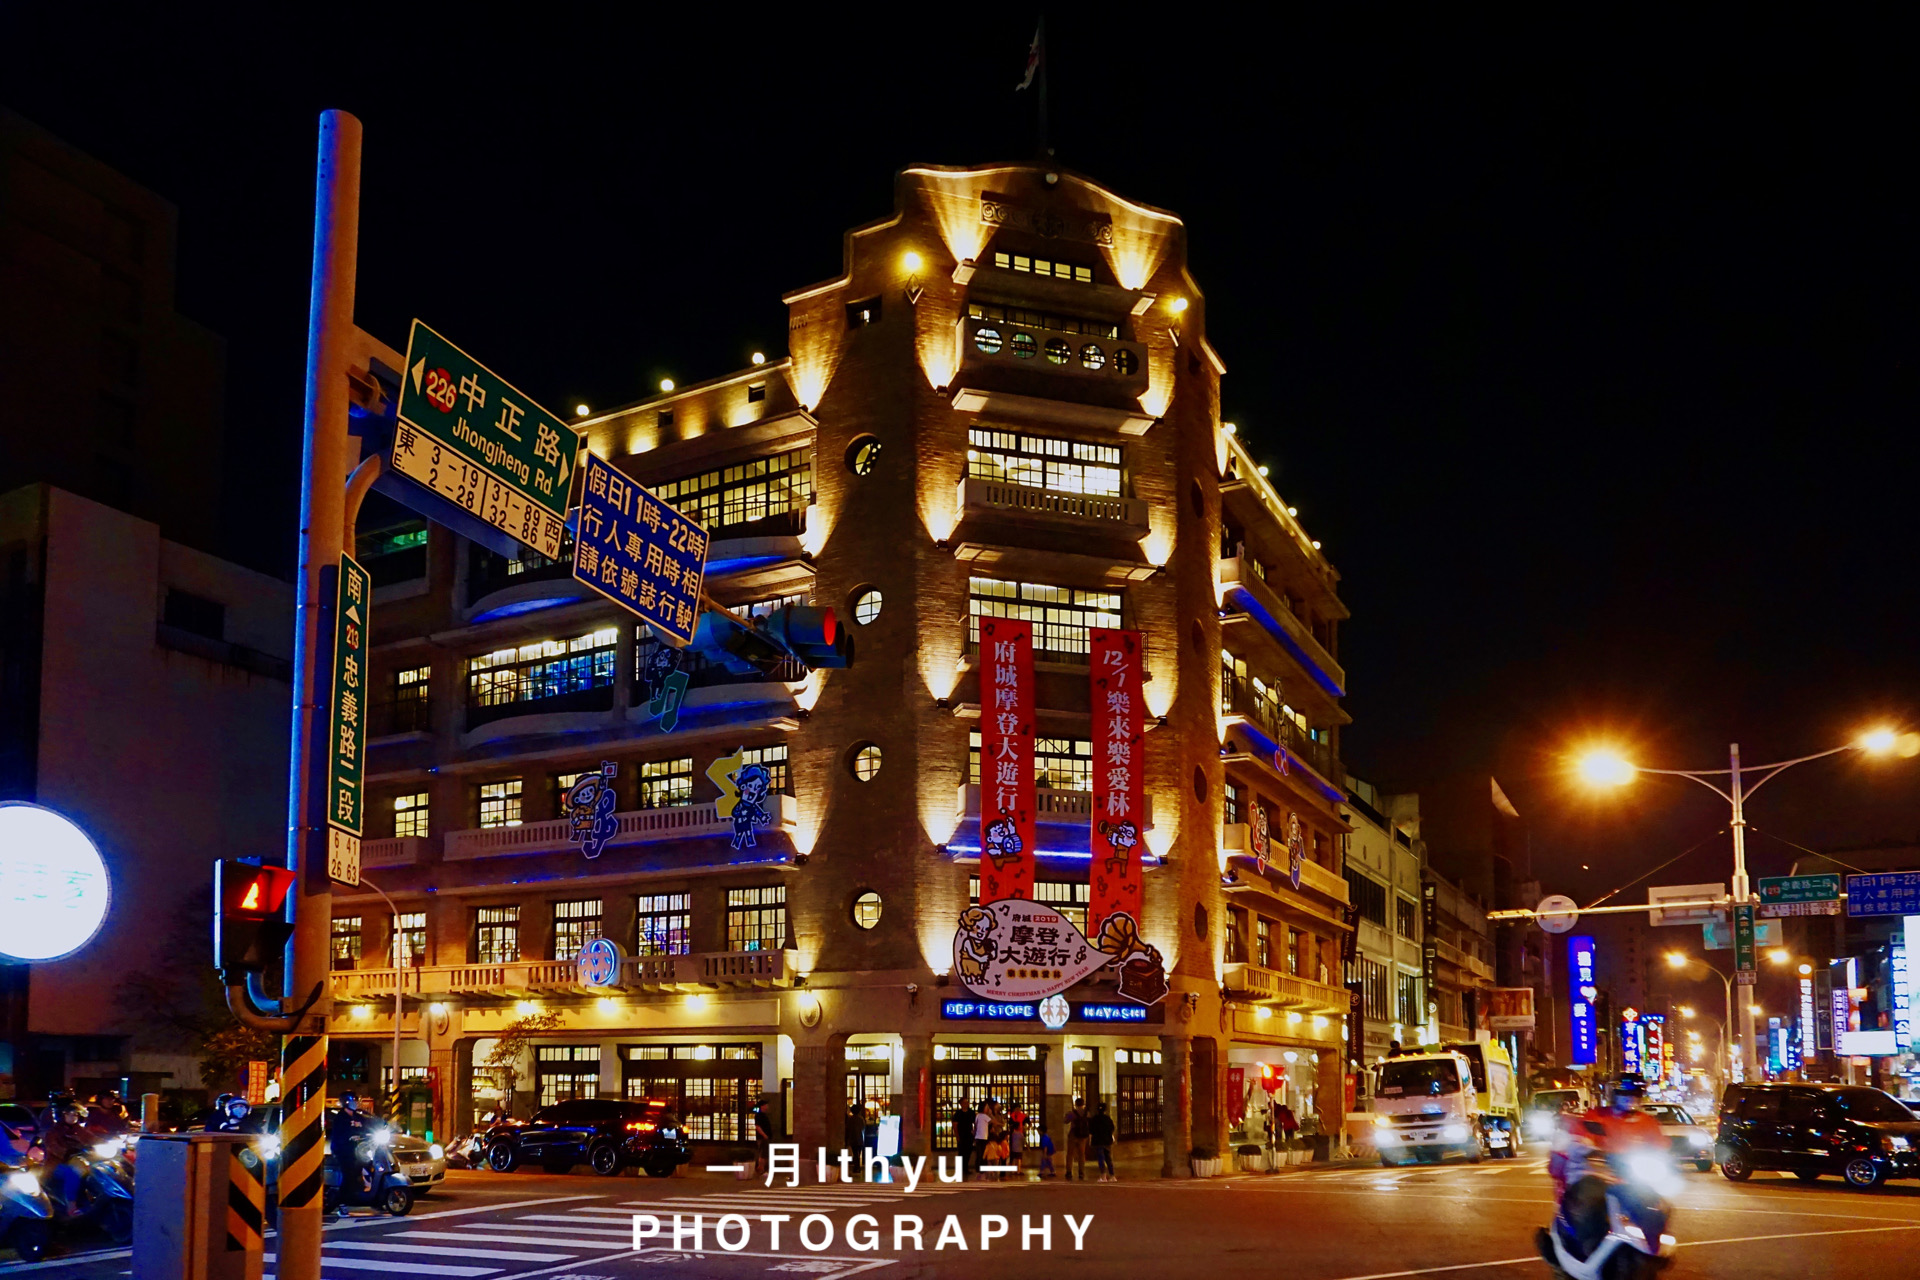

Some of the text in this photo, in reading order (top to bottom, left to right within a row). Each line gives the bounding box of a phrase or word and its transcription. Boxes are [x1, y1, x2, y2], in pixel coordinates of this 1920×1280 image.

[426, 371, 561, 468] 226 中正路
[396, 427, 419, 457] 東
[452, 416, 553, 497] Jhongjheng Rd.
[392, 452, 406, 471] E.
[544, 515, 563, 544] 西
[583, 503, 700, 600] 行人專用時相
[347, 566, 363, 605] 南
[578, 540, 693, 633] 請依號誌行駛
[346, 624, 359, 650] 213
[337, 654, 359, 823] 忠義路二段
[994, 640, 1019, 811] 府城摩登大遊行
[1011, 914, 1031, 923] 府城
[1010, 925, 1060, 946] 摩登
[999, 946, 1071, 966] 大遊行
[986, 989, 1006, 997] MERRY
[1047, 982, 1064, 992] HAPPY
[1064, 975, 1076, 984] NEW
[1084, 1007, 1146, 1019] HAYASHI
